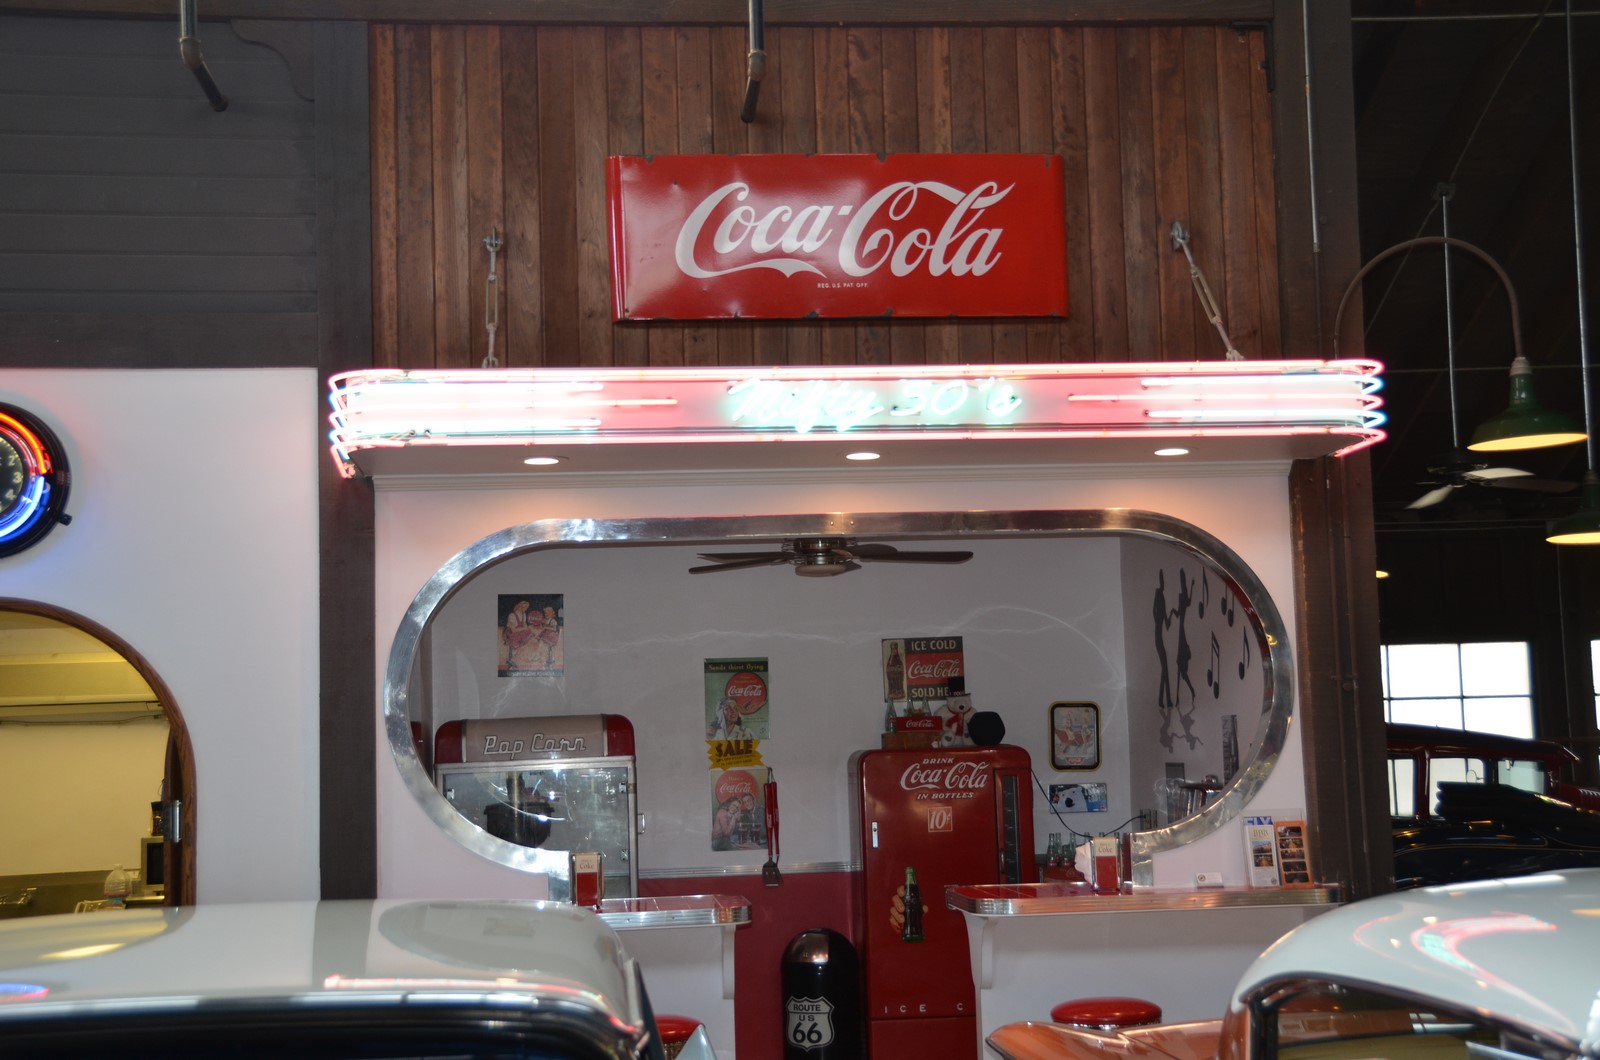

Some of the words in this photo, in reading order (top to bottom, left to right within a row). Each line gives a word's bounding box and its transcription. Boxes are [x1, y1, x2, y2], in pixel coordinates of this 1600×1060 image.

[674, 180, 1016, 279] Coca-Cola
[727, 377, 885, 435] Nifty
[890, 375, 1024, 418] 50's
[8, 455, 16, 466] 2
[12, 471, 22, 484] 3
[5, 489, 16, 501] 4
[911, 640, 927, 651] ICE
[929, 639, 956, 650] COLD
[907, 659, 960, 679] Coca-Cola
[727, 684, 762, 697] Coca-Cola
[911, 687, 935, 698] SOLD
[937, 686, 951, 697] HE
[483, 735, 524, 760] Pop
[530, 732, 587, 753] Corn
[715, 739, 753, 758] SALE
[922, 757, 954, 765] DRINK
[900, 761, 990, 791] Coca-Cola
[931, 791, 974, 800] BOTTLES
[579, 862, 595, 870] Coke
[792, 1003, 822, 1012] ROUTE
[792, 1021, 823, 1045] 66
